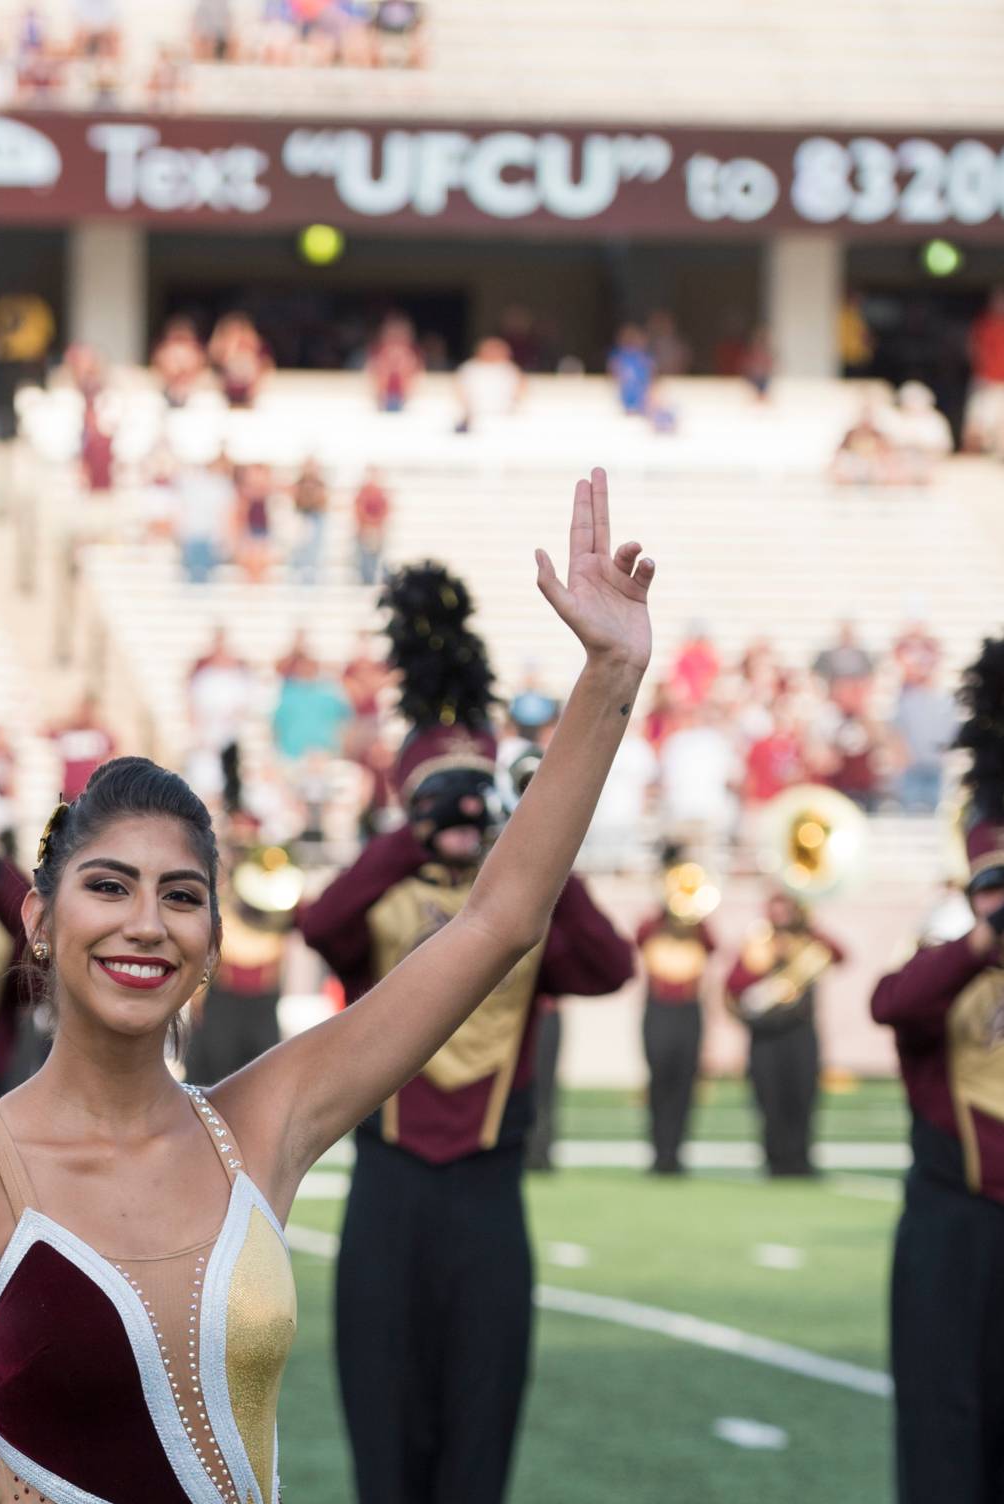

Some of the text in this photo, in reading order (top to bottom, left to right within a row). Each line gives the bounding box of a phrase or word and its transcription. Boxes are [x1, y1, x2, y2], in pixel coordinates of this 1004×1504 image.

[87, 122, 271, 213] Text
[684, 150, 780, 222] to
[790, 136, 1004, 225] 8320
